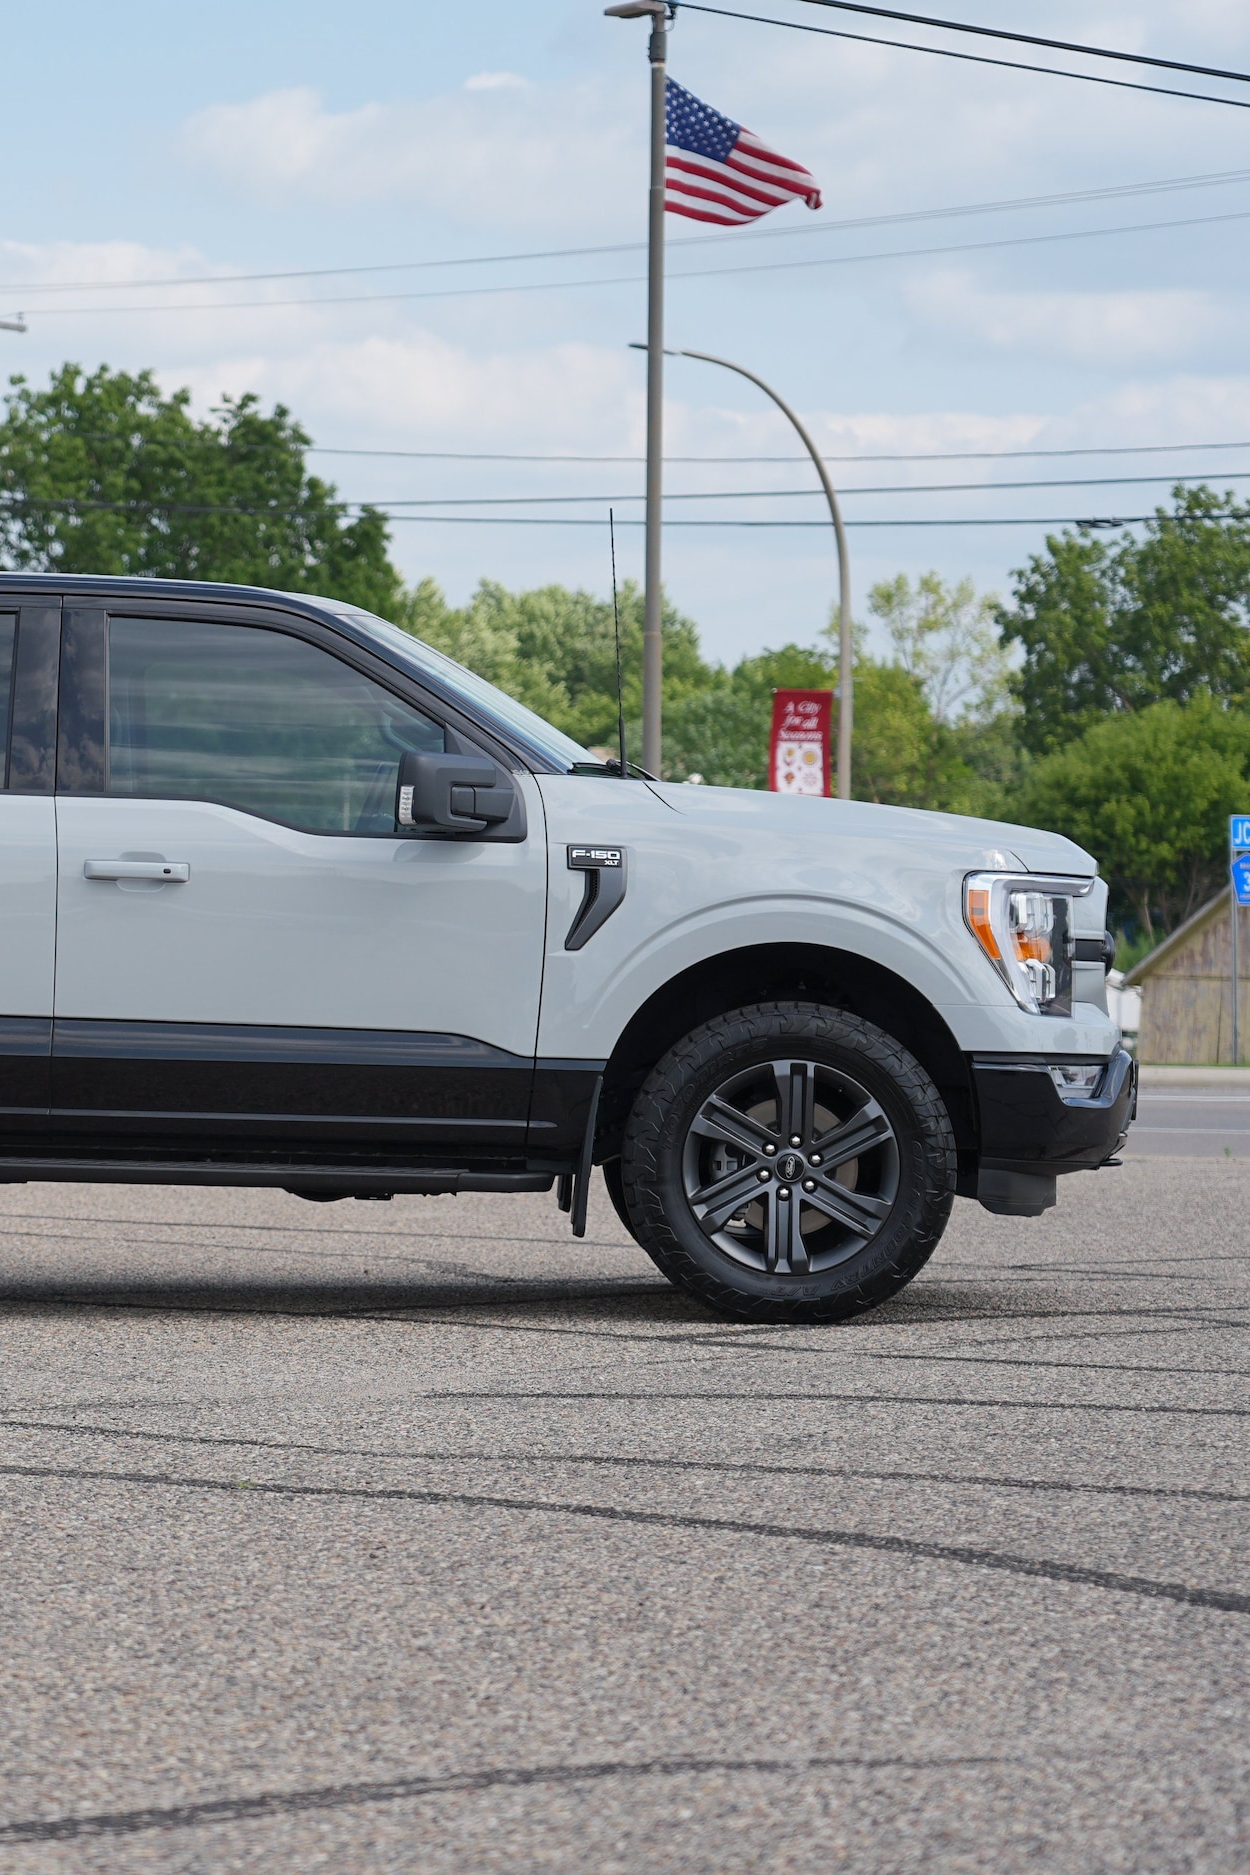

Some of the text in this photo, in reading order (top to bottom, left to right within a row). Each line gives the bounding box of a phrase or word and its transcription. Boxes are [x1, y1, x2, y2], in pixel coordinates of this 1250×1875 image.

[784, 701, 822, 716] A City
[782, 714, 818, 729] for all
[572, 850, 620, 859] F-150
